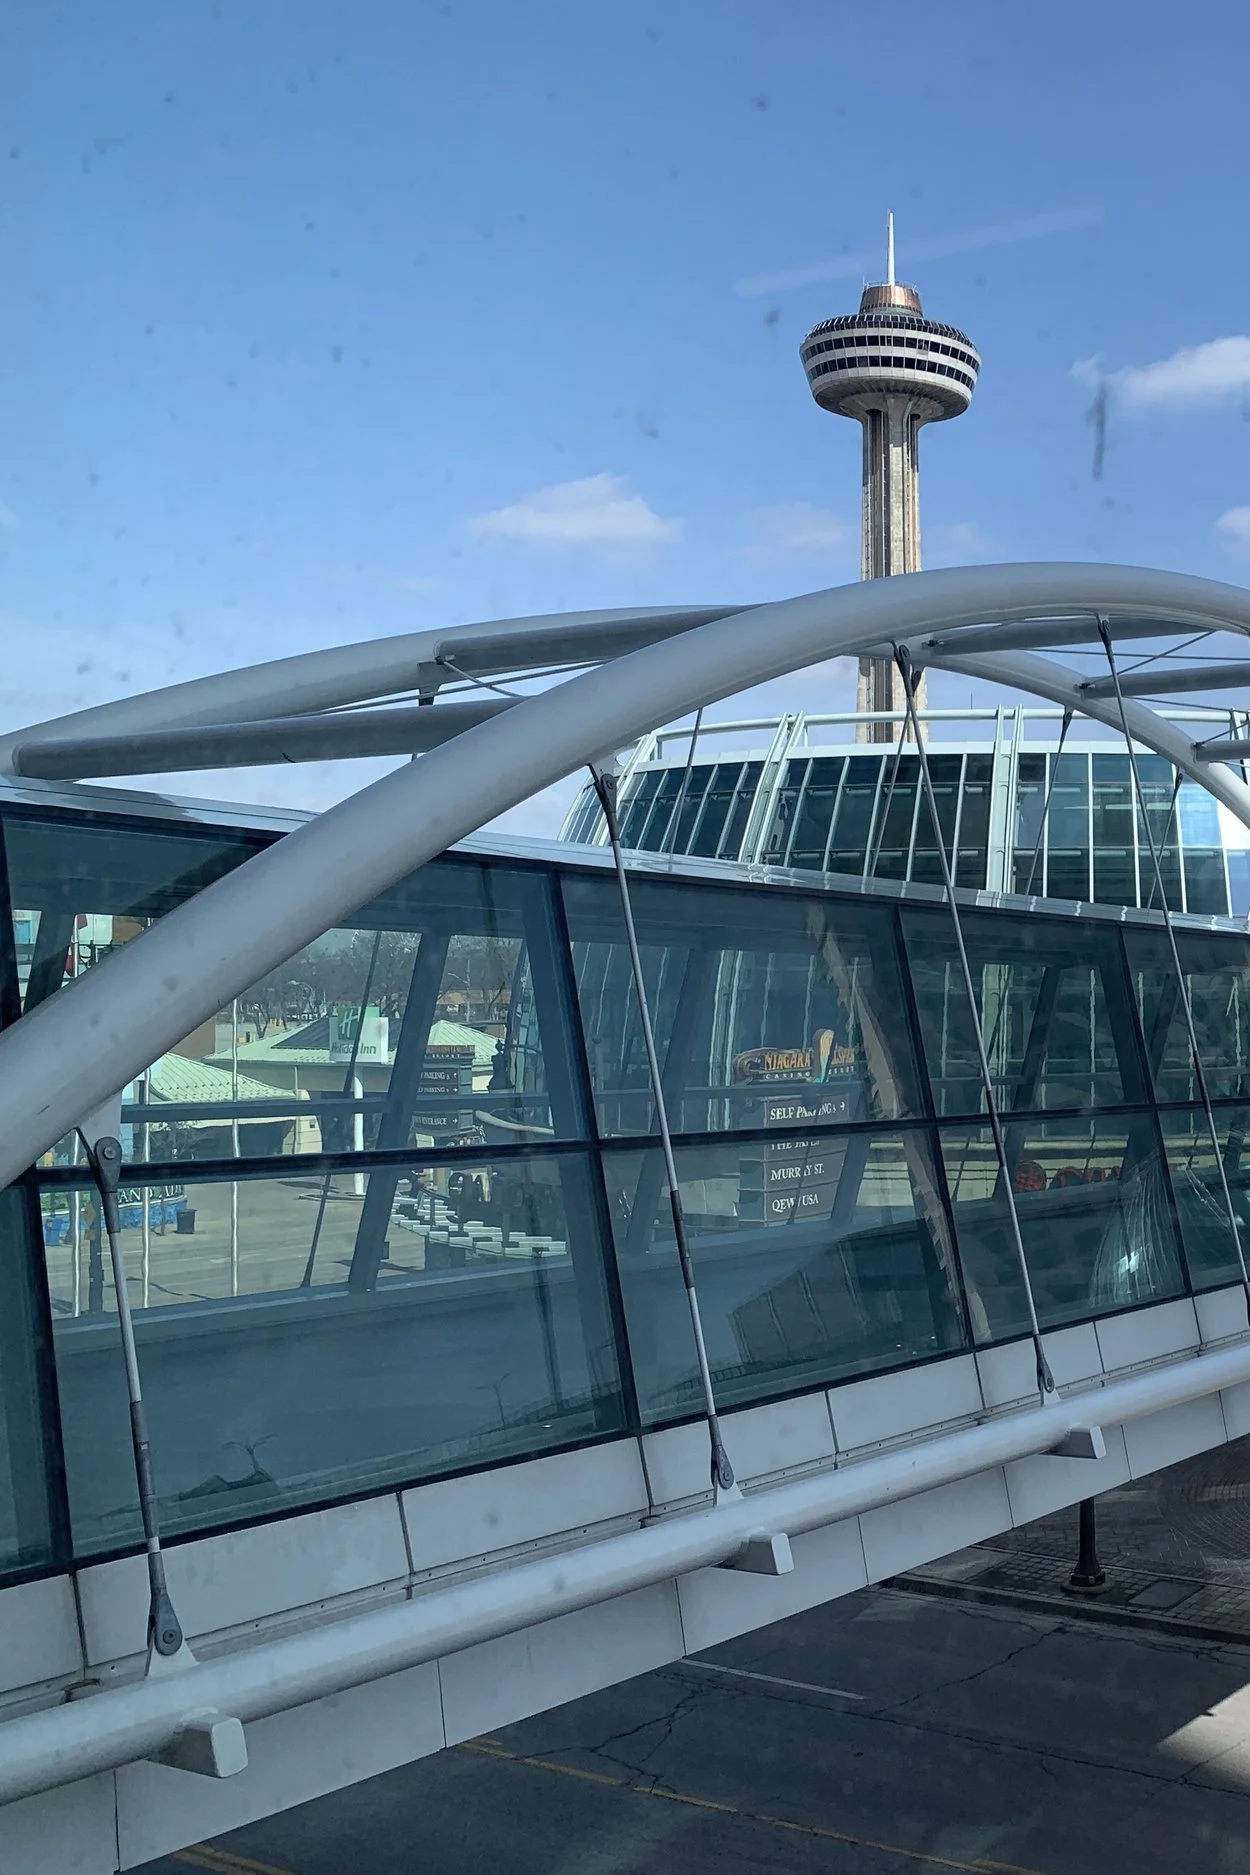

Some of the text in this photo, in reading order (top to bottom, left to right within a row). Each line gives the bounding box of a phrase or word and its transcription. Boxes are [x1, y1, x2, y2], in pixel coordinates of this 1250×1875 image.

[331, 1042, 377, 1055] Holida Inn
[765, 1052, 811, 1071] NIAGARA
[765, 1071, 811, 1080] CASINO
[770, 1106, 795, 1120] SELF
[770, 1163, 825, 1181] MURRY ST.
[771, 1197, 796, 1213] QEW
[802, 1193, 819, 1206] USA
